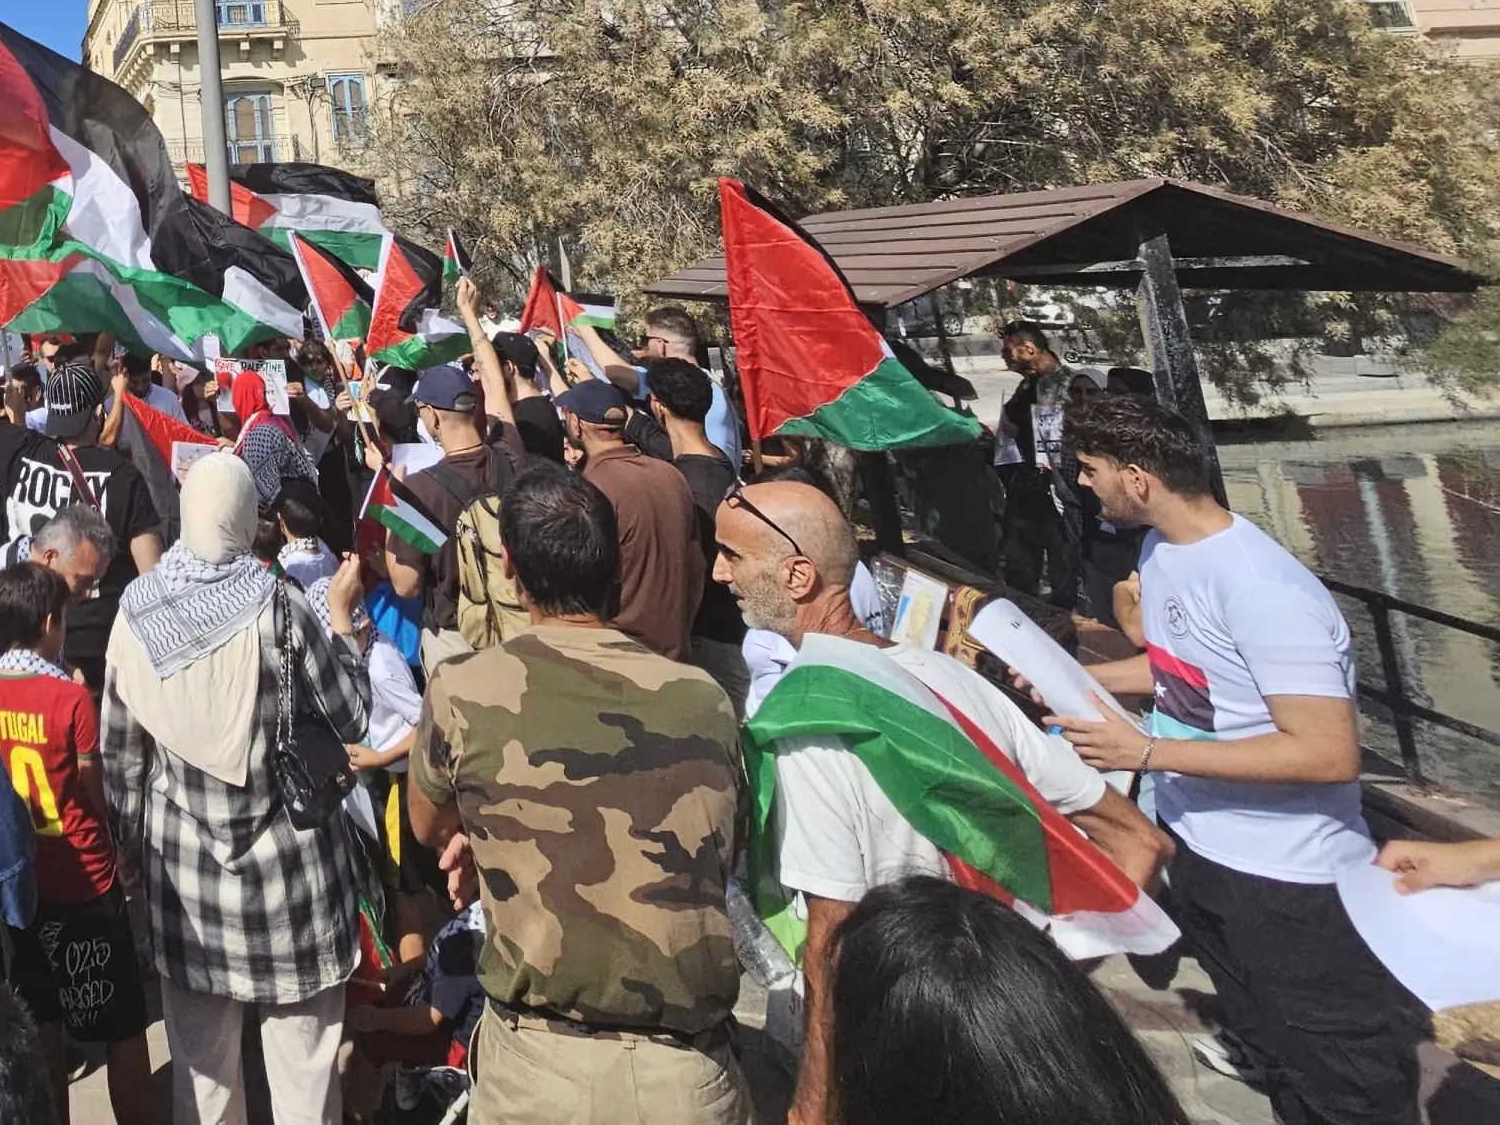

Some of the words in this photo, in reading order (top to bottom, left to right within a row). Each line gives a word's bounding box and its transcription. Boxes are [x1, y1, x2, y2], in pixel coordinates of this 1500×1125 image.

[216, 361, 235, 371] SAVE
[240, 361, 283, 375] PALESTINE
[8, 745, 63, 837] 0
